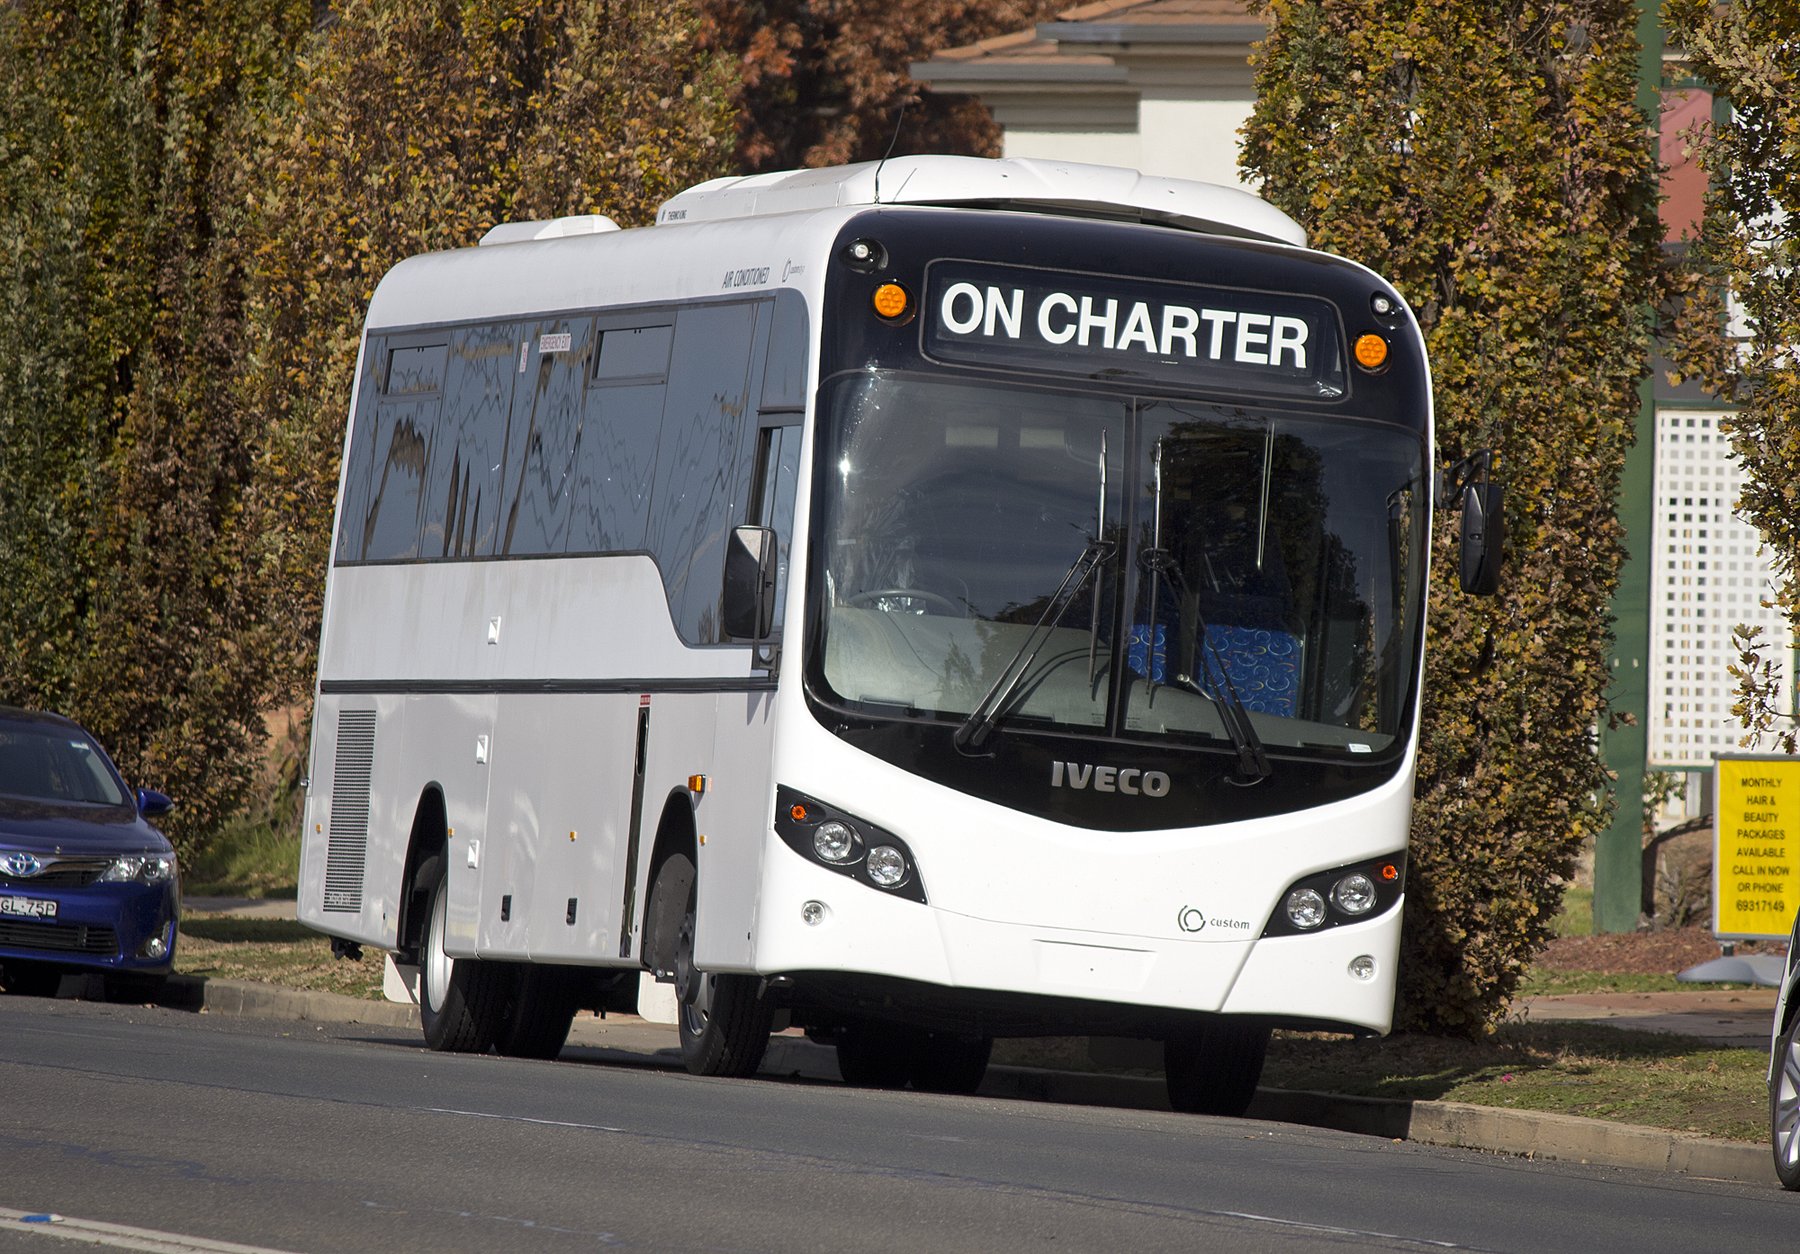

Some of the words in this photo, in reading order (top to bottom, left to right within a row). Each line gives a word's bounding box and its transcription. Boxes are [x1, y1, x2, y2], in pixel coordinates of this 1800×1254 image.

[722, 271, 733, 288] AIR
[733, 267, 770, 286] CONDITIONED
[941, 282, 1025, 340] ON
[1037, 292, 1309, 369] CHARTER
[1051, 760, 1171, 797] IVECO
[1741, 777, 1783, 788] MONTHLY
[1746, 795, 1768, 805] HAIR
[1769, 795, 1776, 806] &
[1744, 812, 1779, 822] BEAUTY
[1737, 829, 1786, 840] PACKAGES
[1736, 847, 1786, 858] AVAILABLE
[1732, 865, 1754, 876] CALL
[1757, 865, 1767, 876] IN
[1768, 866, 1790, 876] NOW
[1737, 882, 1751, 892] OR
[1753, 882, 1784, 893] PHONE
[1736, 899, 1785, 912] 69317149
[1210, 918, 1250, 930] custom
